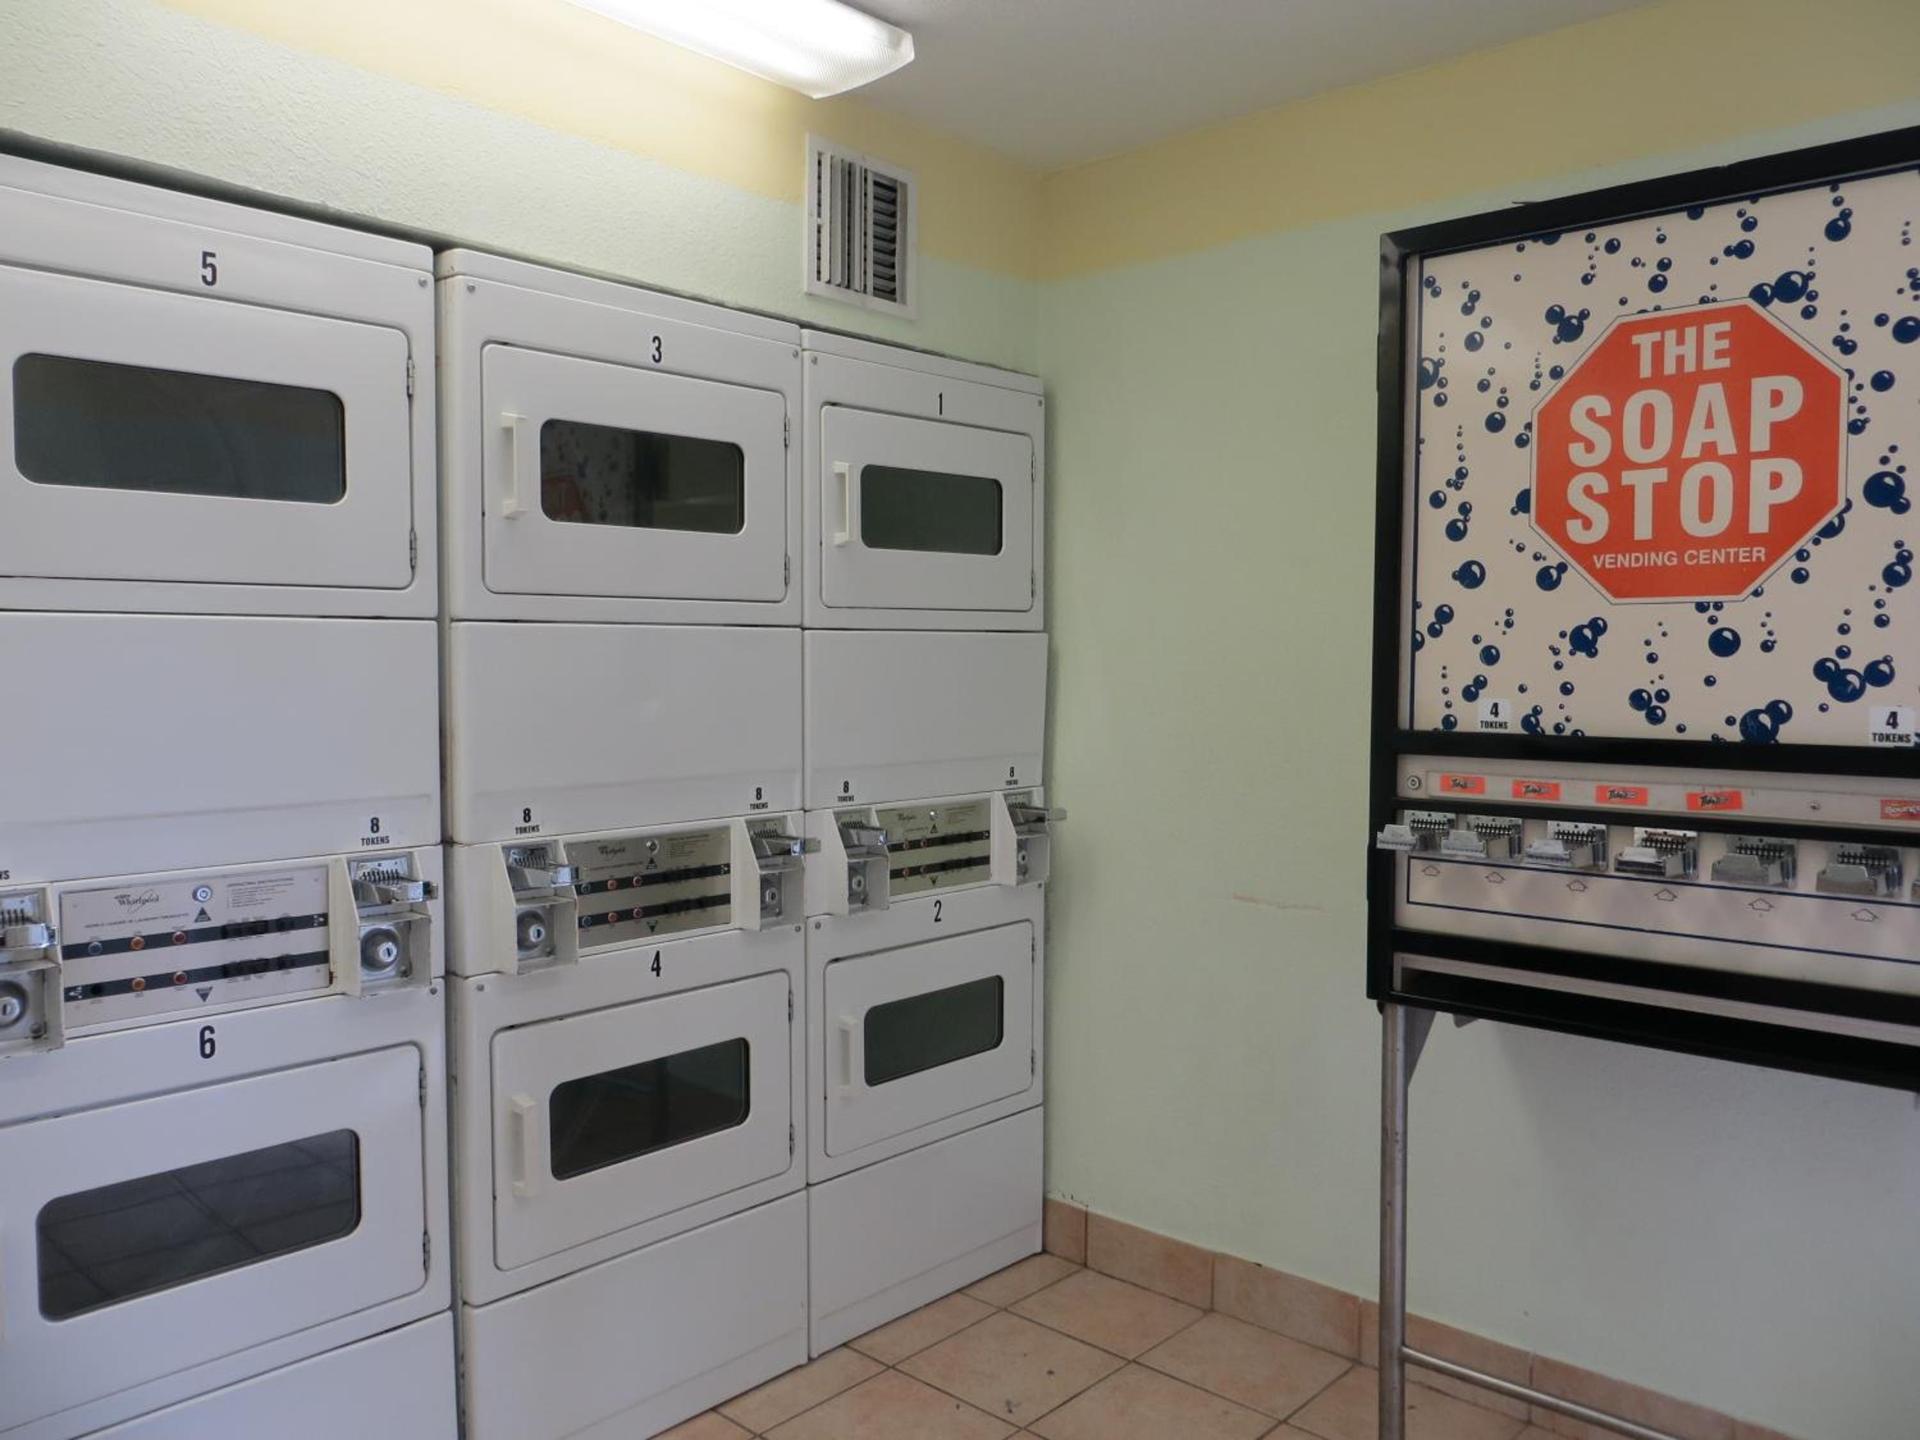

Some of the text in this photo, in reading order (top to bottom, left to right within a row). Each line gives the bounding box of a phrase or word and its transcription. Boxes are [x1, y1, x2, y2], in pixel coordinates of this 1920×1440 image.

[201, 252, 218, 287] 5
[651, 335, 662, 364] 3
[1631, 321, 1731, 379] THE
[938, 392, 943, 416] 1
[1568, 375, 1804, 468] SOAP
[1566, 457, 1803, 545] STOP
[1592, 547, 1766, 569] VENDING CENTER
[1489, 702, 1499, 717] 4
[1885, 711, 1899, 729] 4
[1480, 720, 1508, 729] TOKENS
[1872, 732, 1912, 743] TOKENS
[755, 787, 763, 800] 8
[843, 780, 850, 793] 8
[370, 817, 380, 833] 8
[523, 808, 532, 823] 8
[360, 836, 390, 846] TOKENS
[934, 900, 942, 922] 2
[651, 950, 661, 977] 4
[200, 1025, 216, 1059] 6
